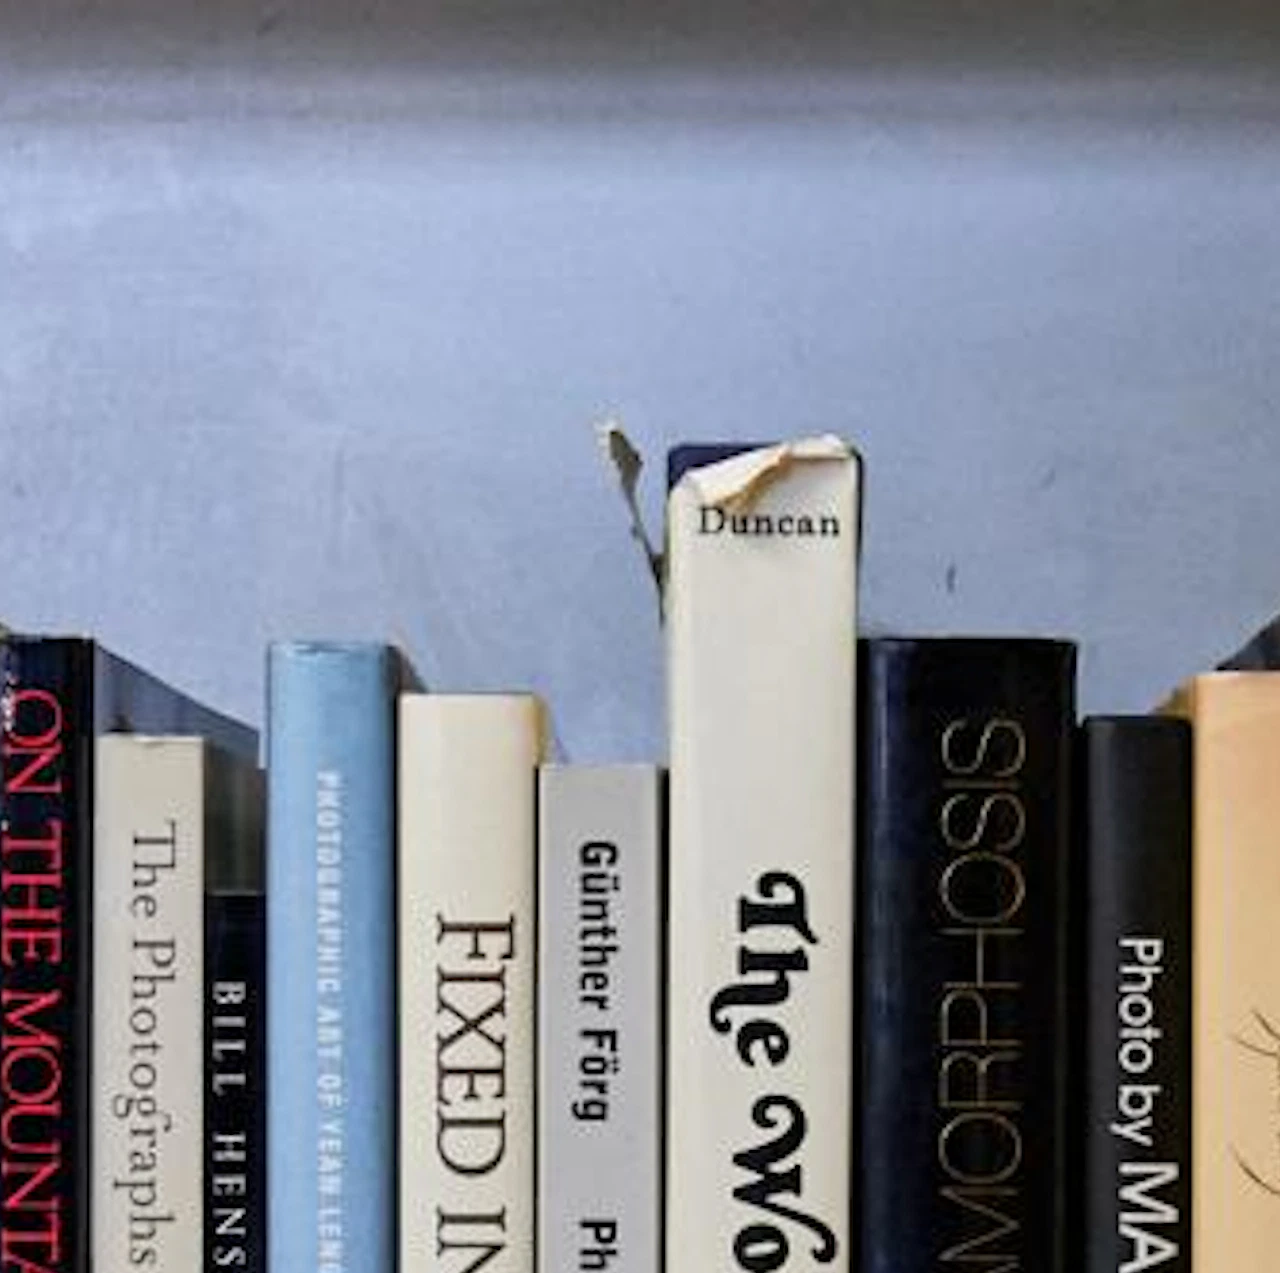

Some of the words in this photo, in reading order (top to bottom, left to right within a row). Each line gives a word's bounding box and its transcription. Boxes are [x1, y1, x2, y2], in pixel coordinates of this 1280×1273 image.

[697, 503, 841, 539] Duncan
[1, 688, 65, 796] ON
[0, 820, 65, 967] THE
[129, 819, 178, 919] The
[314, 771, 344, 993] PHOTOGRAPHIC
[579, 840, 622, 1011] Günther
[708, 872, 817, 1070] The
[212, 980, 247, 1097] BILL
[314, 1006, 344, 1058] ART
[435, 913, 519, 1178] FIXED
[1114, 937, 1164, 1072] Photo
[112, 938, 177, 1266] Photographs
[314, 1073, 344, 1108] OF
[570, 1029, 621, 1123] Förg
[1108, 1086, 1163, 1146] by
[314, 1120, 344, 1194] YEAN
